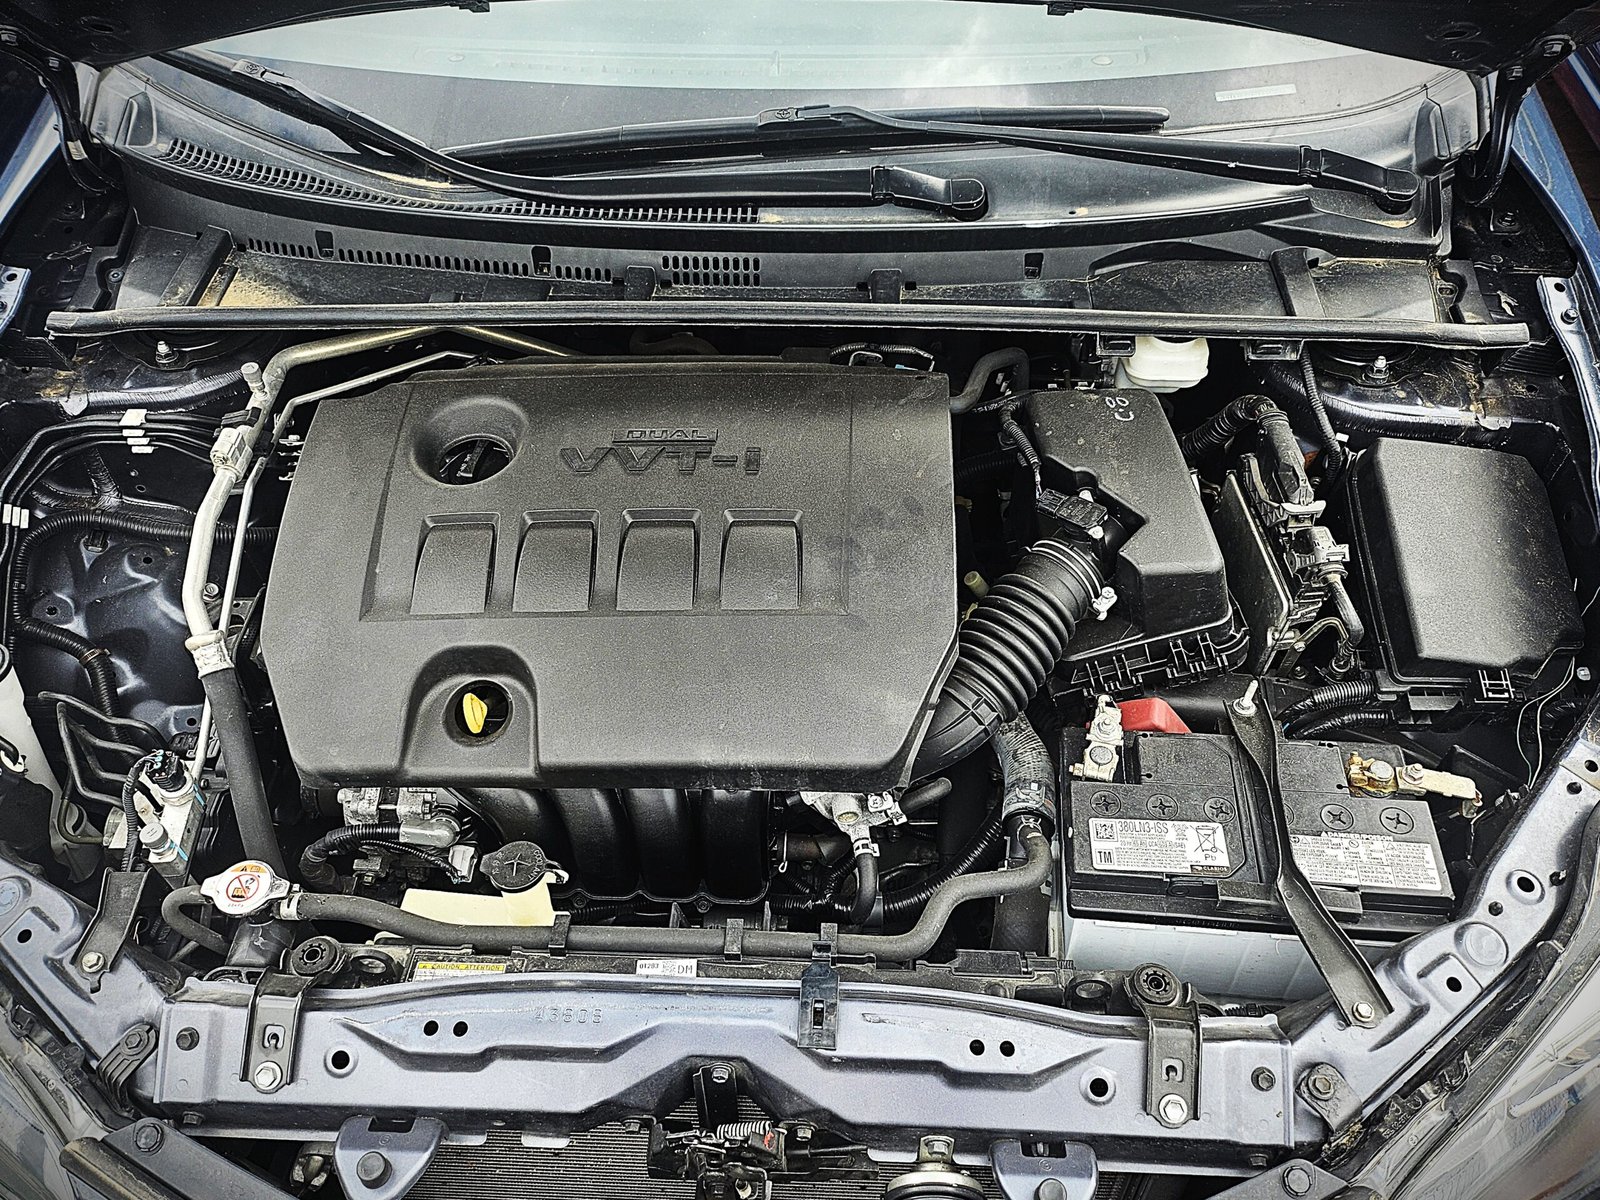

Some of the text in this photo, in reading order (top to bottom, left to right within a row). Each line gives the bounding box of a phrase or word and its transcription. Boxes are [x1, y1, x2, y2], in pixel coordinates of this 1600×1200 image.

[626, 429, 708, 440] DUAL
[1118, 820, 1169, 834] 380LN3-ISS
[1098, 850, 1113, 864] TM
[432, 962, 501, 971] CAUTION ATTENTION
